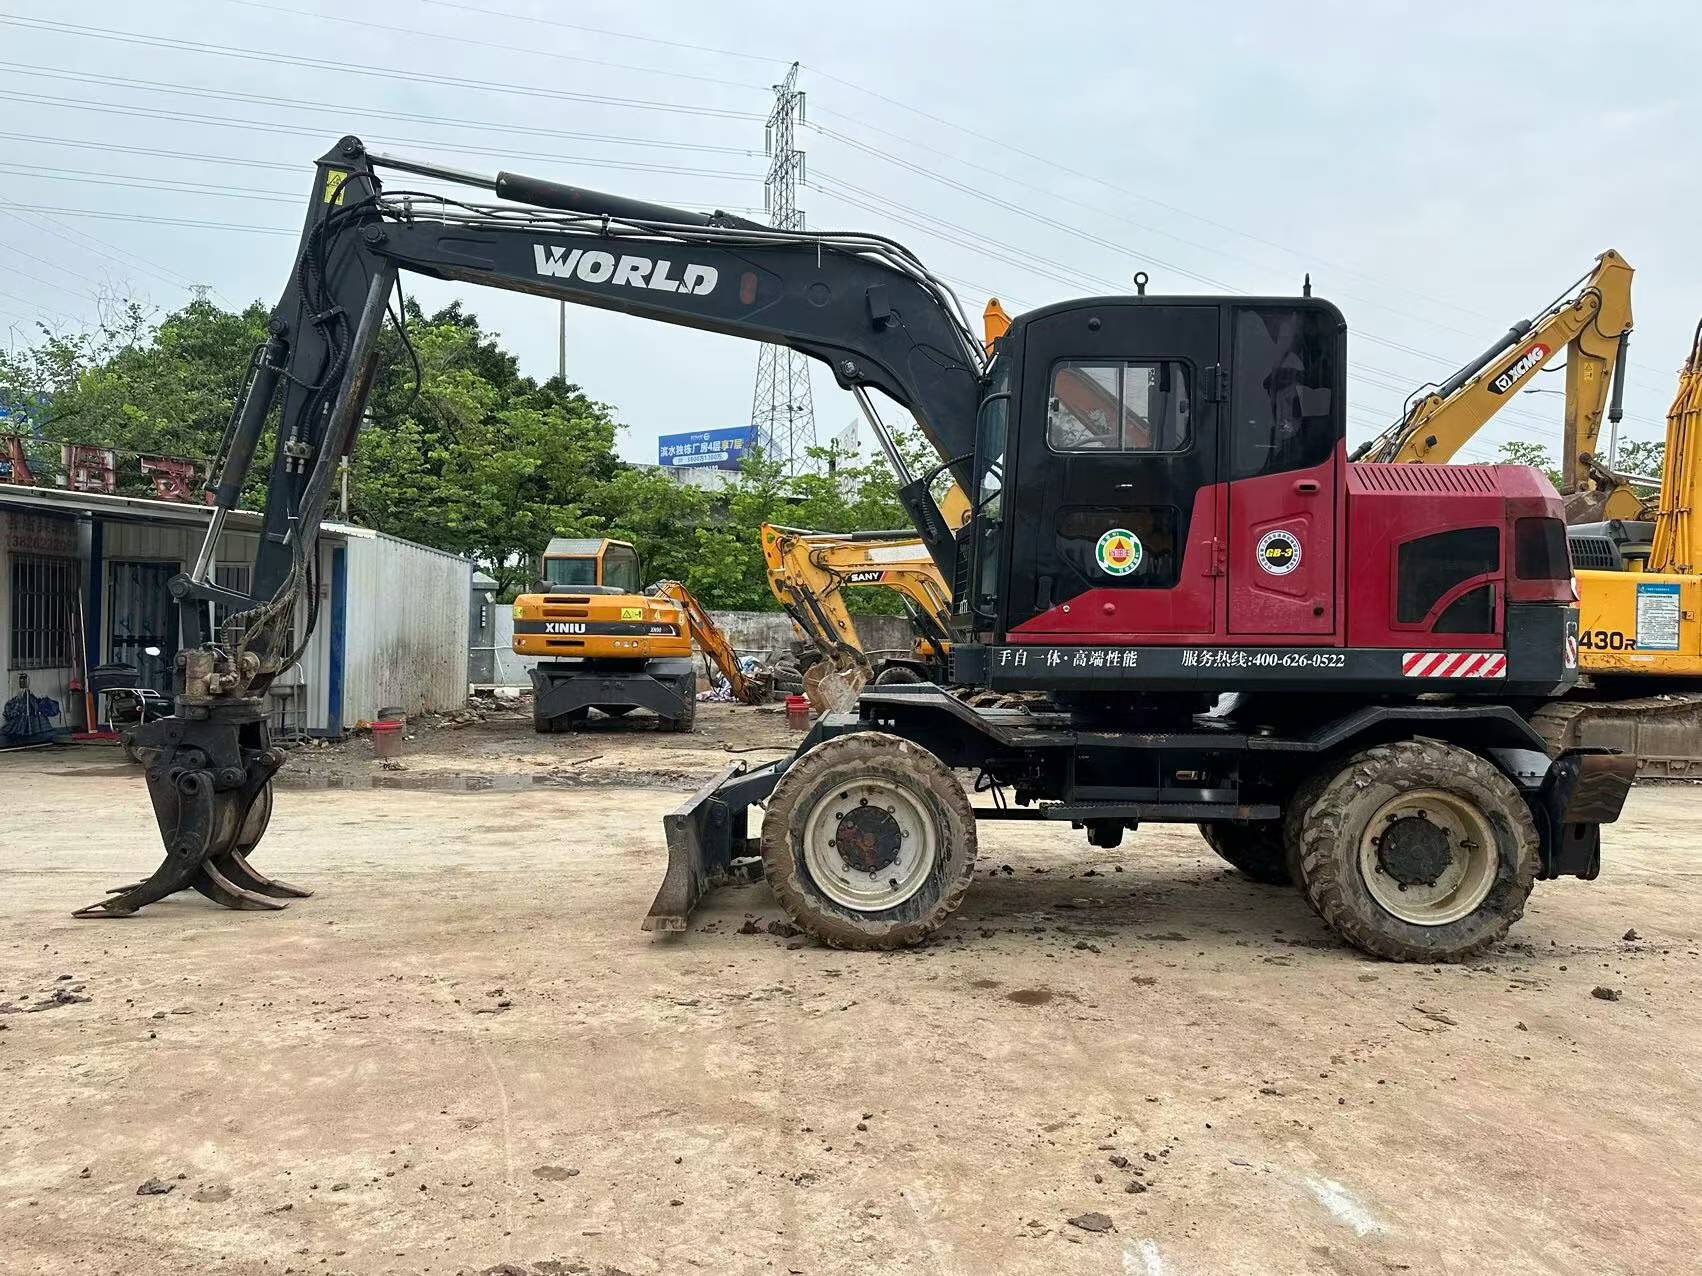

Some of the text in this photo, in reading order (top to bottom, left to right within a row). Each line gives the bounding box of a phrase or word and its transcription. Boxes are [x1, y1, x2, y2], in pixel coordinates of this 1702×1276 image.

[533, 244, 719, 296] WORLD
[1507, 346, 1544, 383] XCMG
[1265, 548, 1293, 557] GB-3
[851, 572, 880, 582] SANY
[545, 622, 586, 633] XINIU
